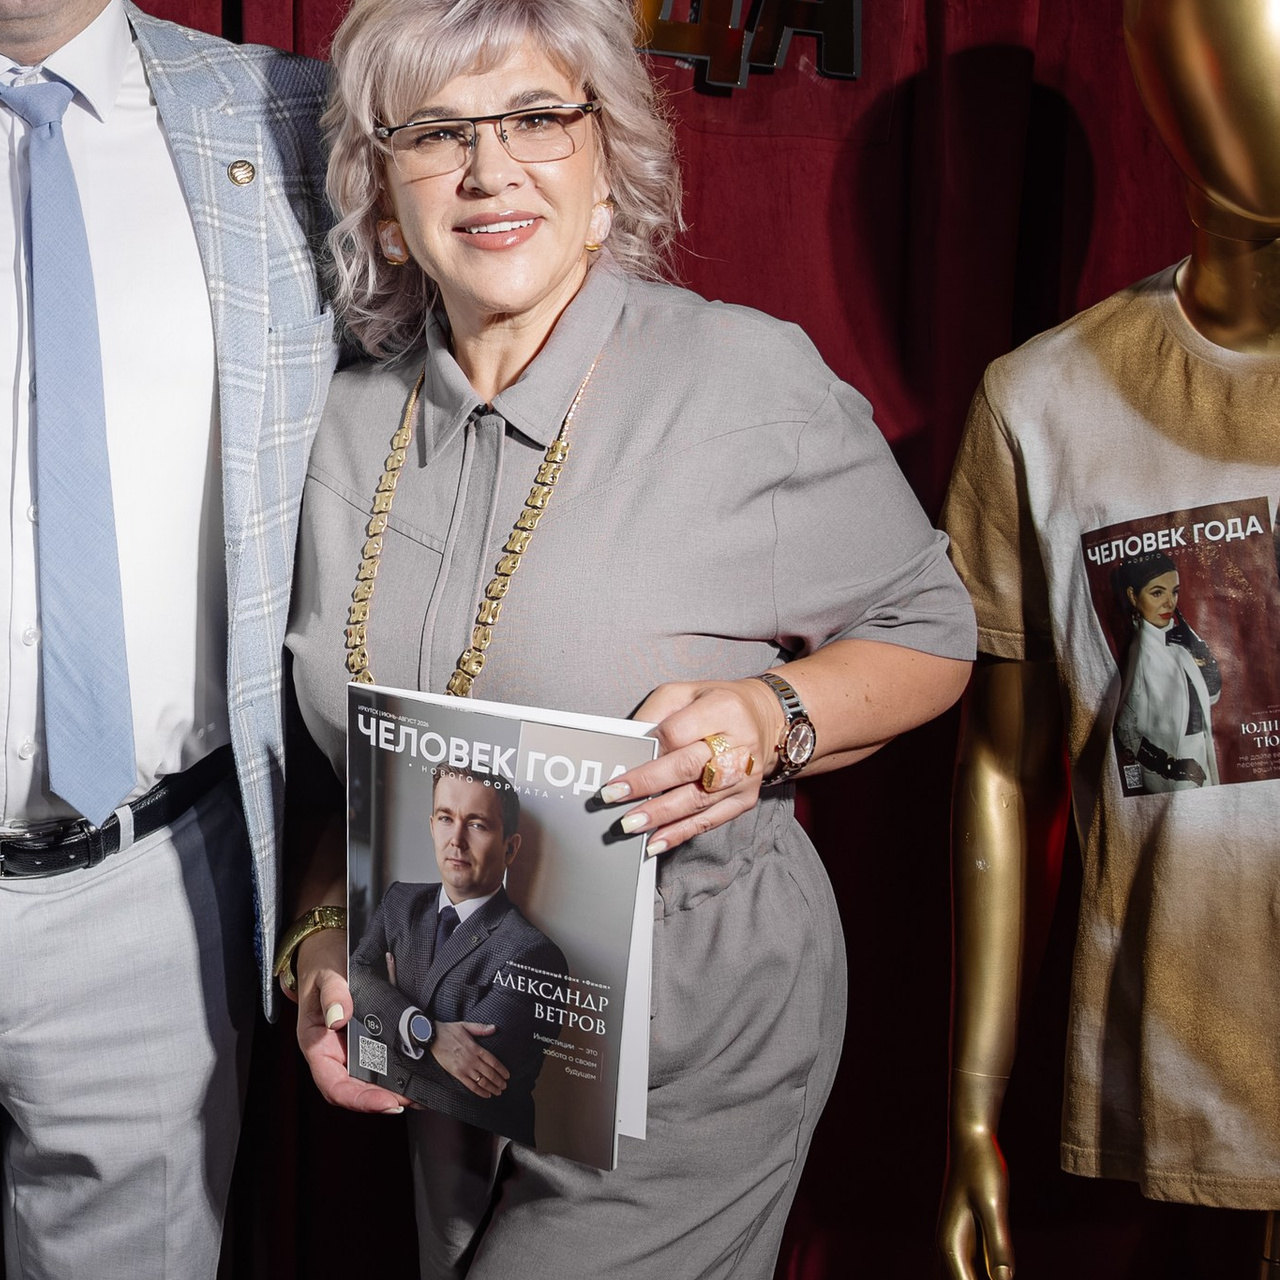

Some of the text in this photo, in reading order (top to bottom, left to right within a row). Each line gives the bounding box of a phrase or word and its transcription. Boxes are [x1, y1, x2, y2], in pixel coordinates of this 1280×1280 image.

[1087, 526, 1187, 565] ЧЕЛОВЕК
[1193, 515, 1264, 543] ГОДА
[358, 713, 516, 778] ЧЕЛОВЕК
[421, 765, 549, 798] НОВОГО ФОРМАТА
[493, 970, 609, 1012] АЛЕКСАНДР
[367, 1020, 379, 1029] 18+
[534, 1003, 606, 1035] ВЕТРОВ
[533, 1032, 574, 1050] Инвестиции
[542, 1048, 567, 1060] забота
[575, 1057, 597, 1068] своем
[565, 1066, 596, 1080] будущем
